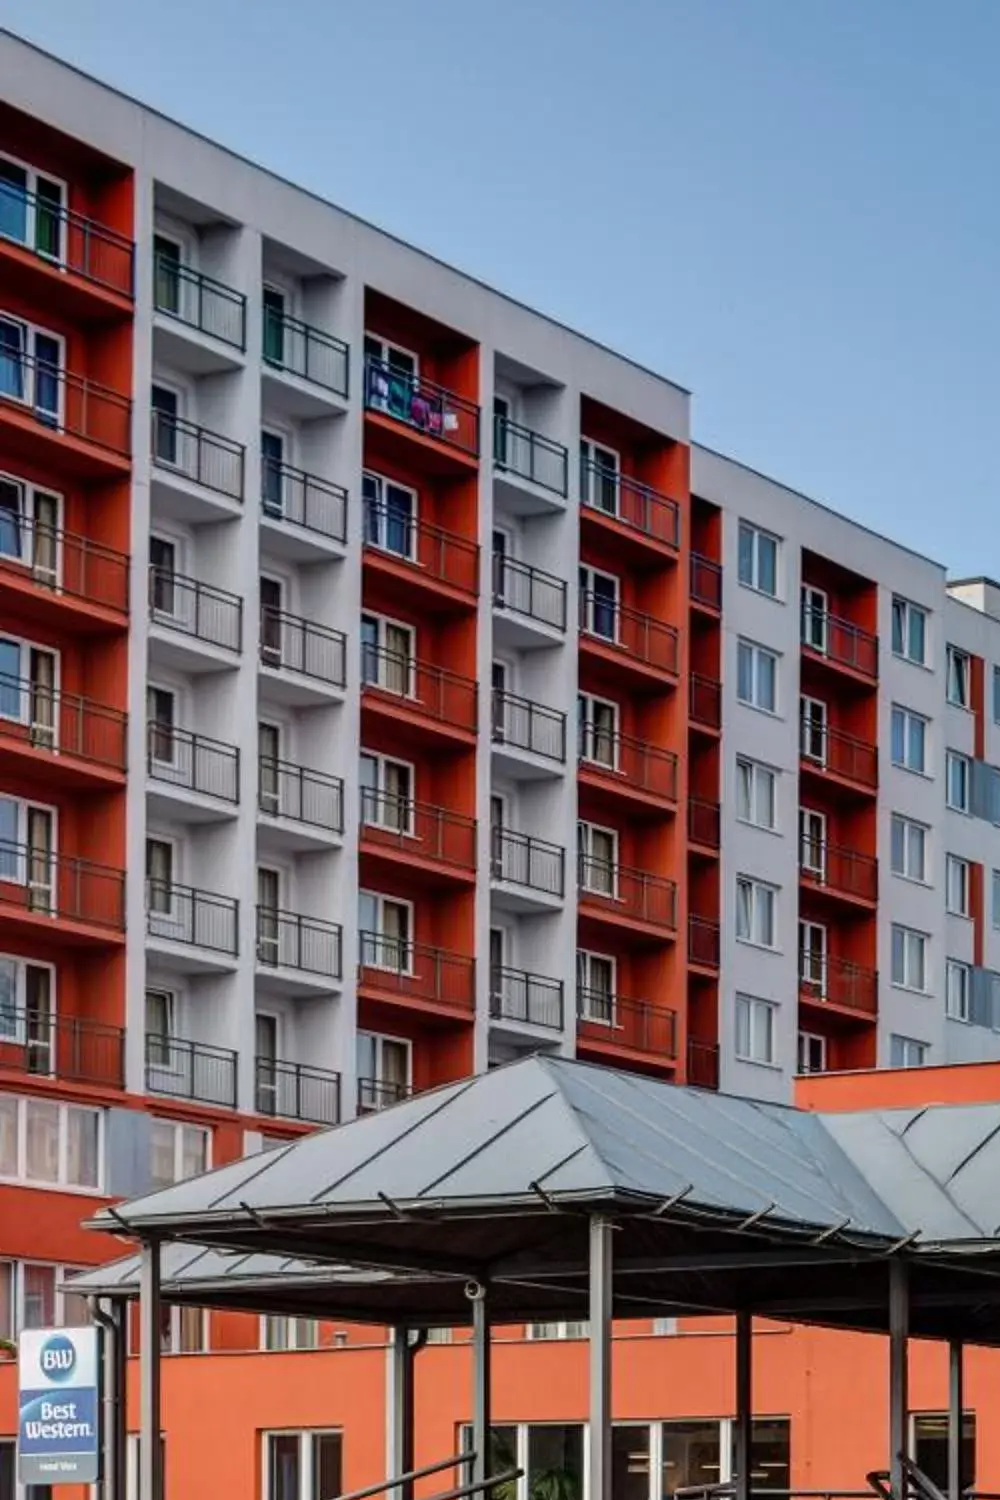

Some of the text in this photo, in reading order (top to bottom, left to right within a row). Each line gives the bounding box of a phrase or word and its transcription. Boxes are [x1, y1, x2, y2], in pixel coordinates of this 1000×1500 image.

[44, 1349, 73, 1369] BW
[41, 1402, 76, 1420] Best
[25, 1421, 90, 1439] Western
